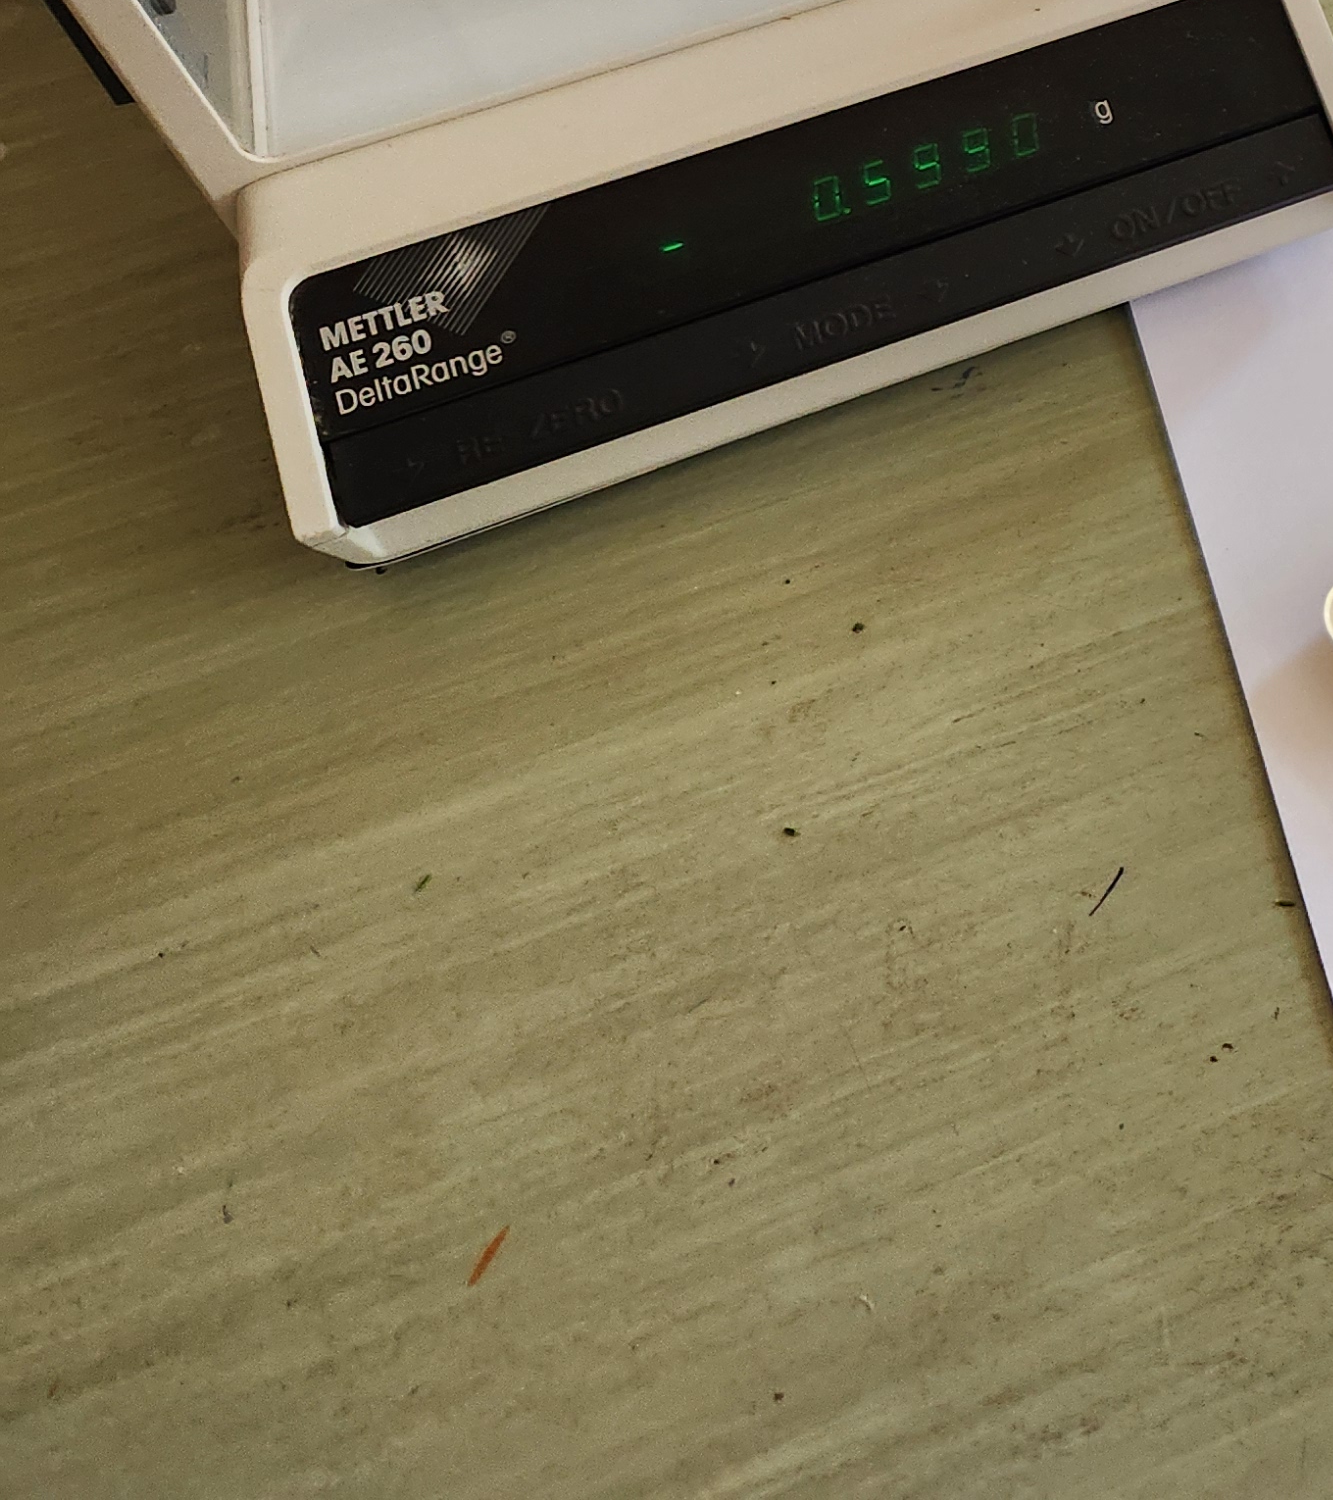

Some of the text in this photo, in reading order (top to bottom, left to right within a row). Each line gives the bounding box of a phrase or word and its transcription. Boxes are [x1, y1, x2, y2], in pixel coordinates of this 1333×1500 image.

[1094, 99, 1114, 125] g
[319, 291, 451, 352] METTLER
[330, 328, 433, 384] AE 260
